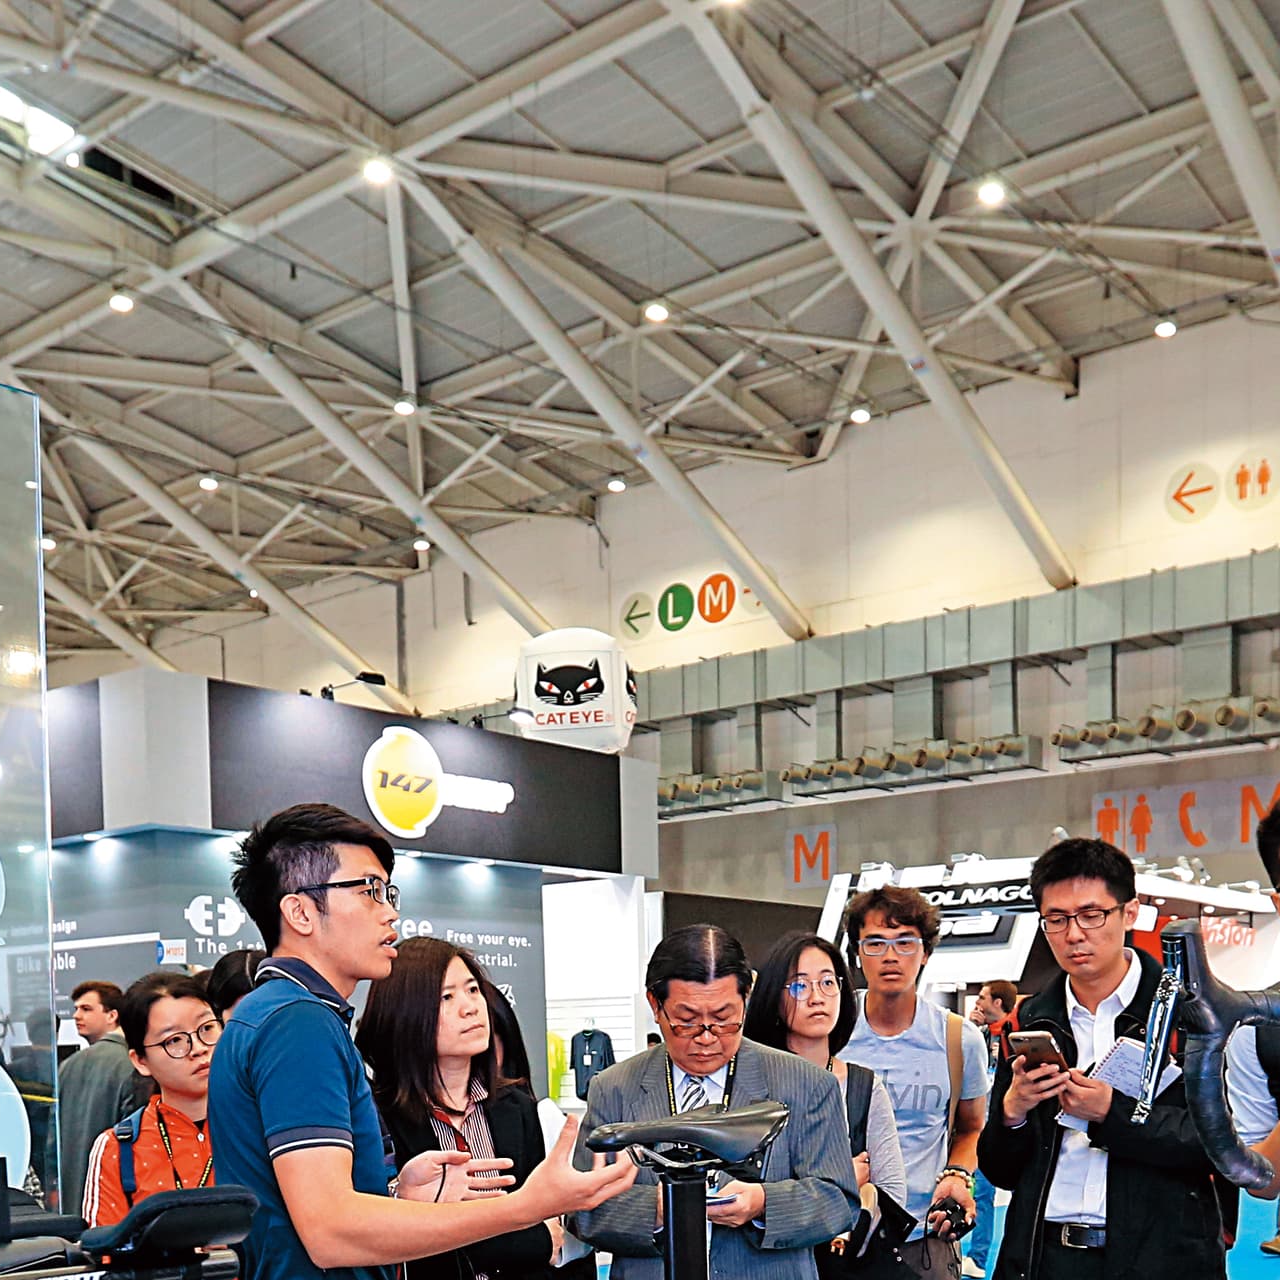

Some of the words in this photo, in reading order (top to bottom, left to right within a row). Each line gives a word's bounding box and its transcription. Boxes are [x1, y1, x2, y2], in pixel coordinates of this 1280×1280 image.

[667, 592, 685, 625] L
[705, 581, 728, 614] M
[535, 709, 604, 725] CATEYE
[794, 831, 830, 883] M
[194, 936, 227, 955] The
[446, 929, 474, 944] Free
[477, 933, 504, 949] your
[508, 935, 533, 951] eye.
